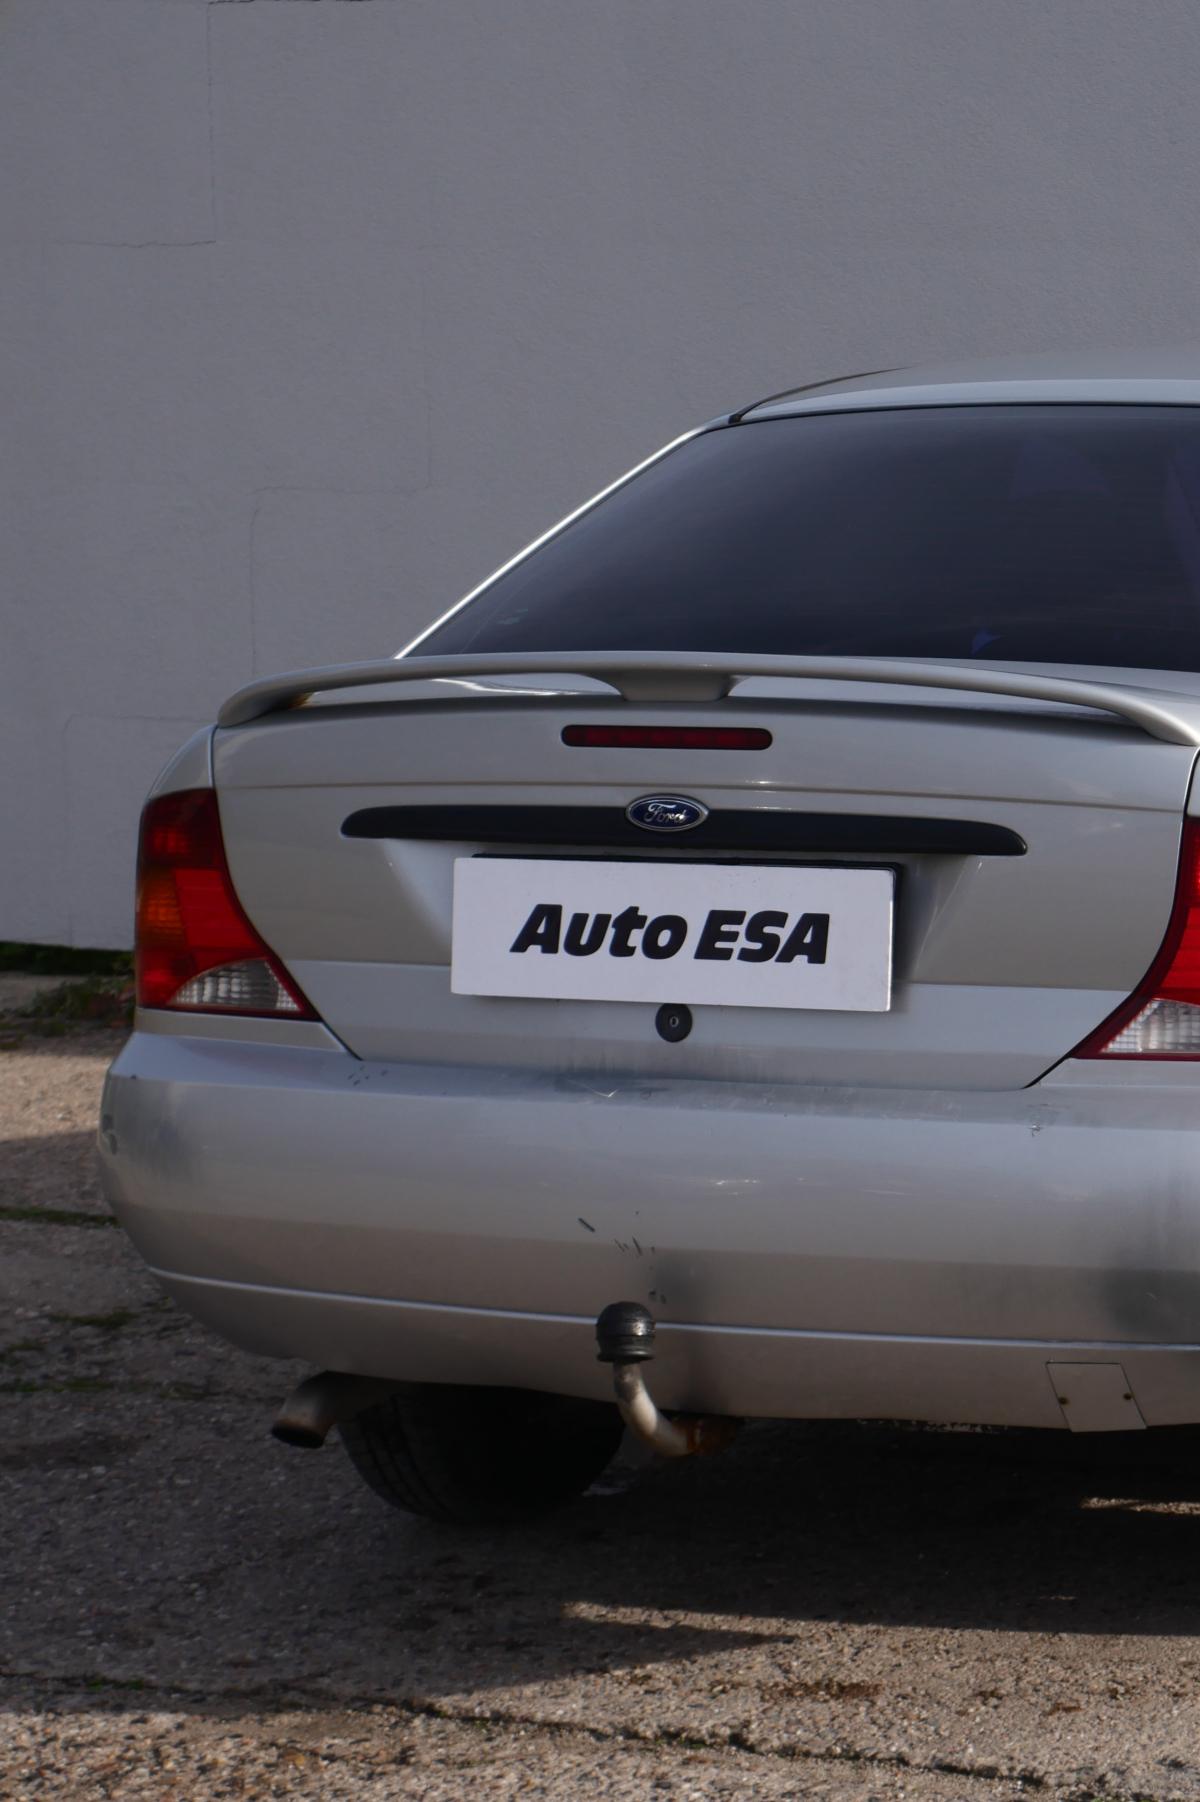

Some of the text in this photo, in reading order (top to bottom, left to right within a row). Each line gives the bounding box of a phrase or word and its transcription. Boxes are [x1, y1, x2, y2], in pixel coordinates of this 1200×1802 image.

[643, 802, 688, 823] Ford
[510, 903, 830, 965] Auto ESA
